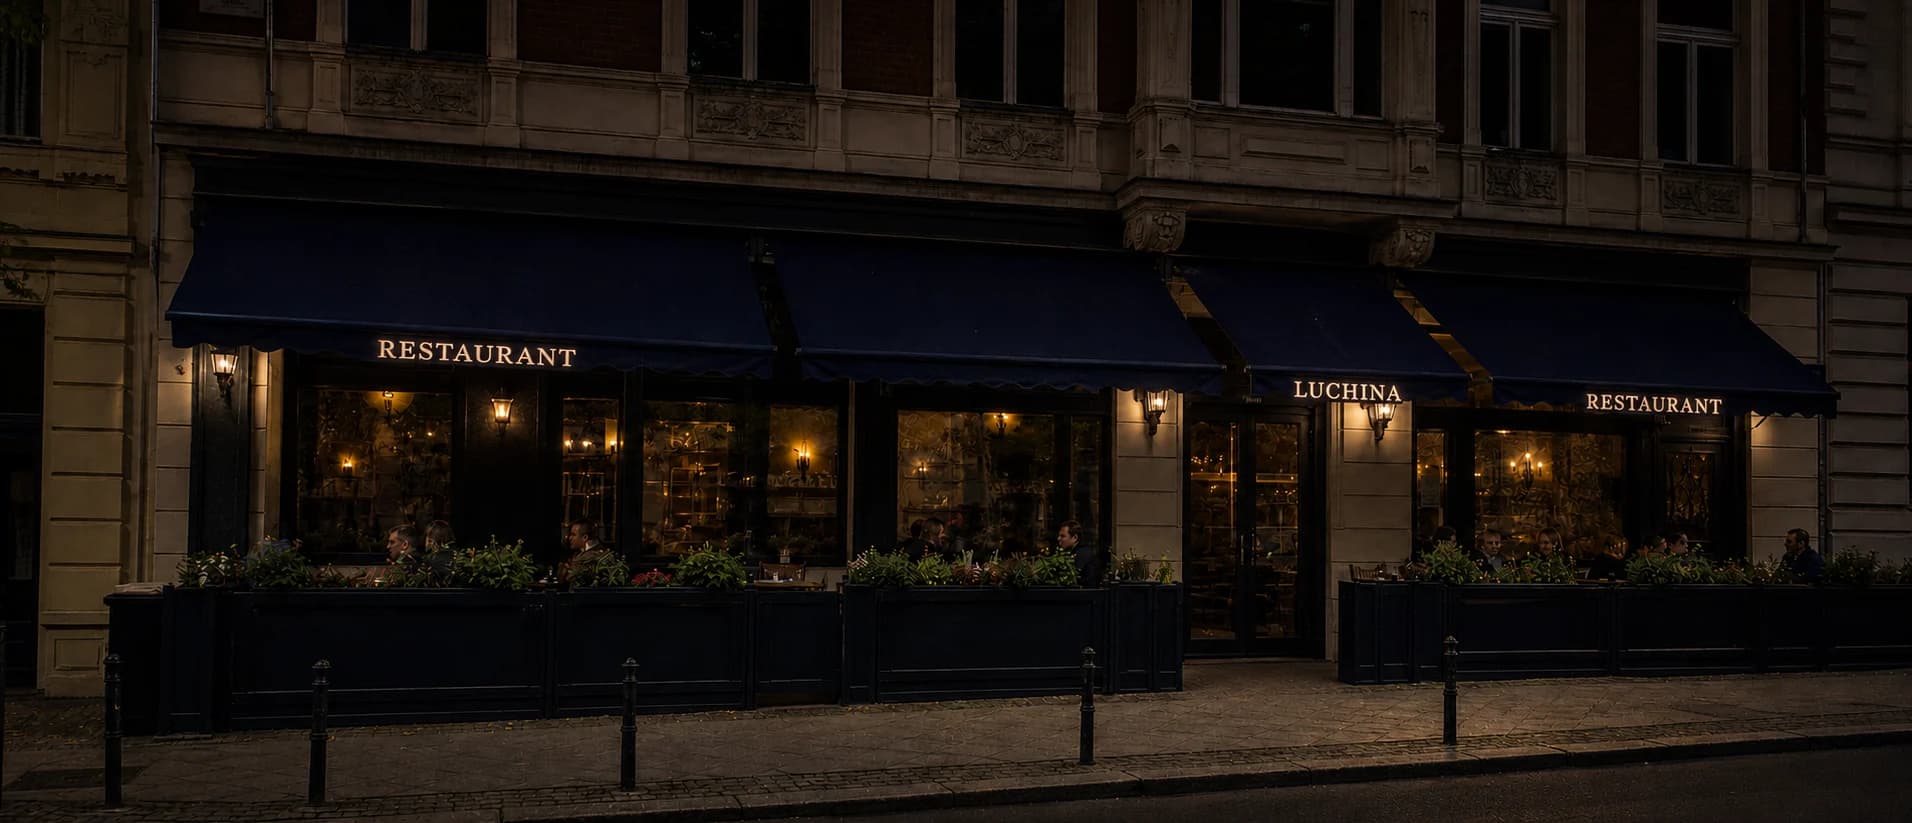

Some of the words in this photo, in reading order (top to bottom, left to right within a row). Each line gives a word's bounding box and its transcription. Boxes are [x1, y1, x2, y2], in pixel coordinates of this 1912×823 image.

[377, 339, 577, 367] RESTAURANT
[1293, 380, 1402, 402] LUCHINA
[1586, 393, 1722, 415] RESTAURANT
